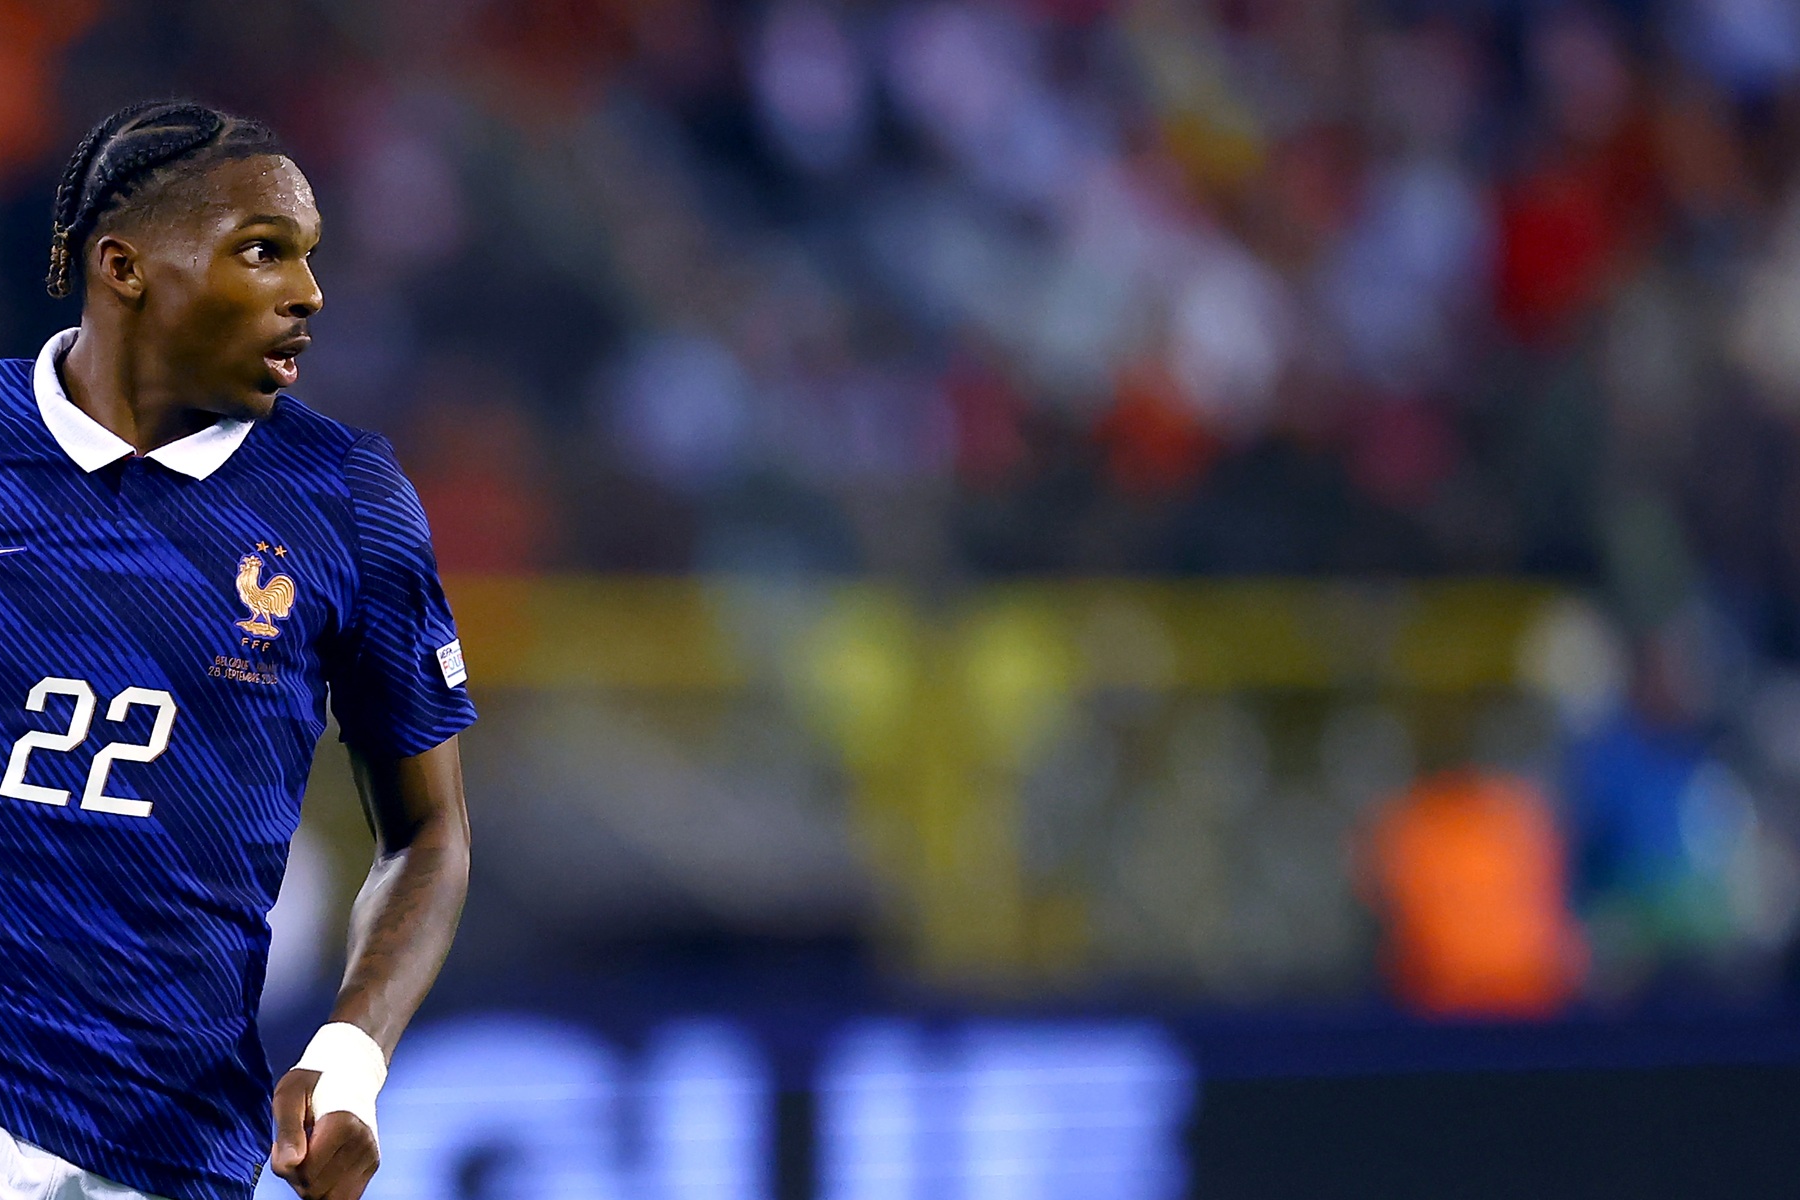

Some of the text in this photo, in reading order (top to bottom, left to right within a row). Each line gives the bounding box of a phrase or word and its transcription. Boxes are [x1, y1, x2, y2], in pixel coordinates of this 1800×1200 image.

[241, 637, 271, 652] FFF
[208, 665, 221, 677] 28
[223, 667, 260, 684] SEPTEMBRE
